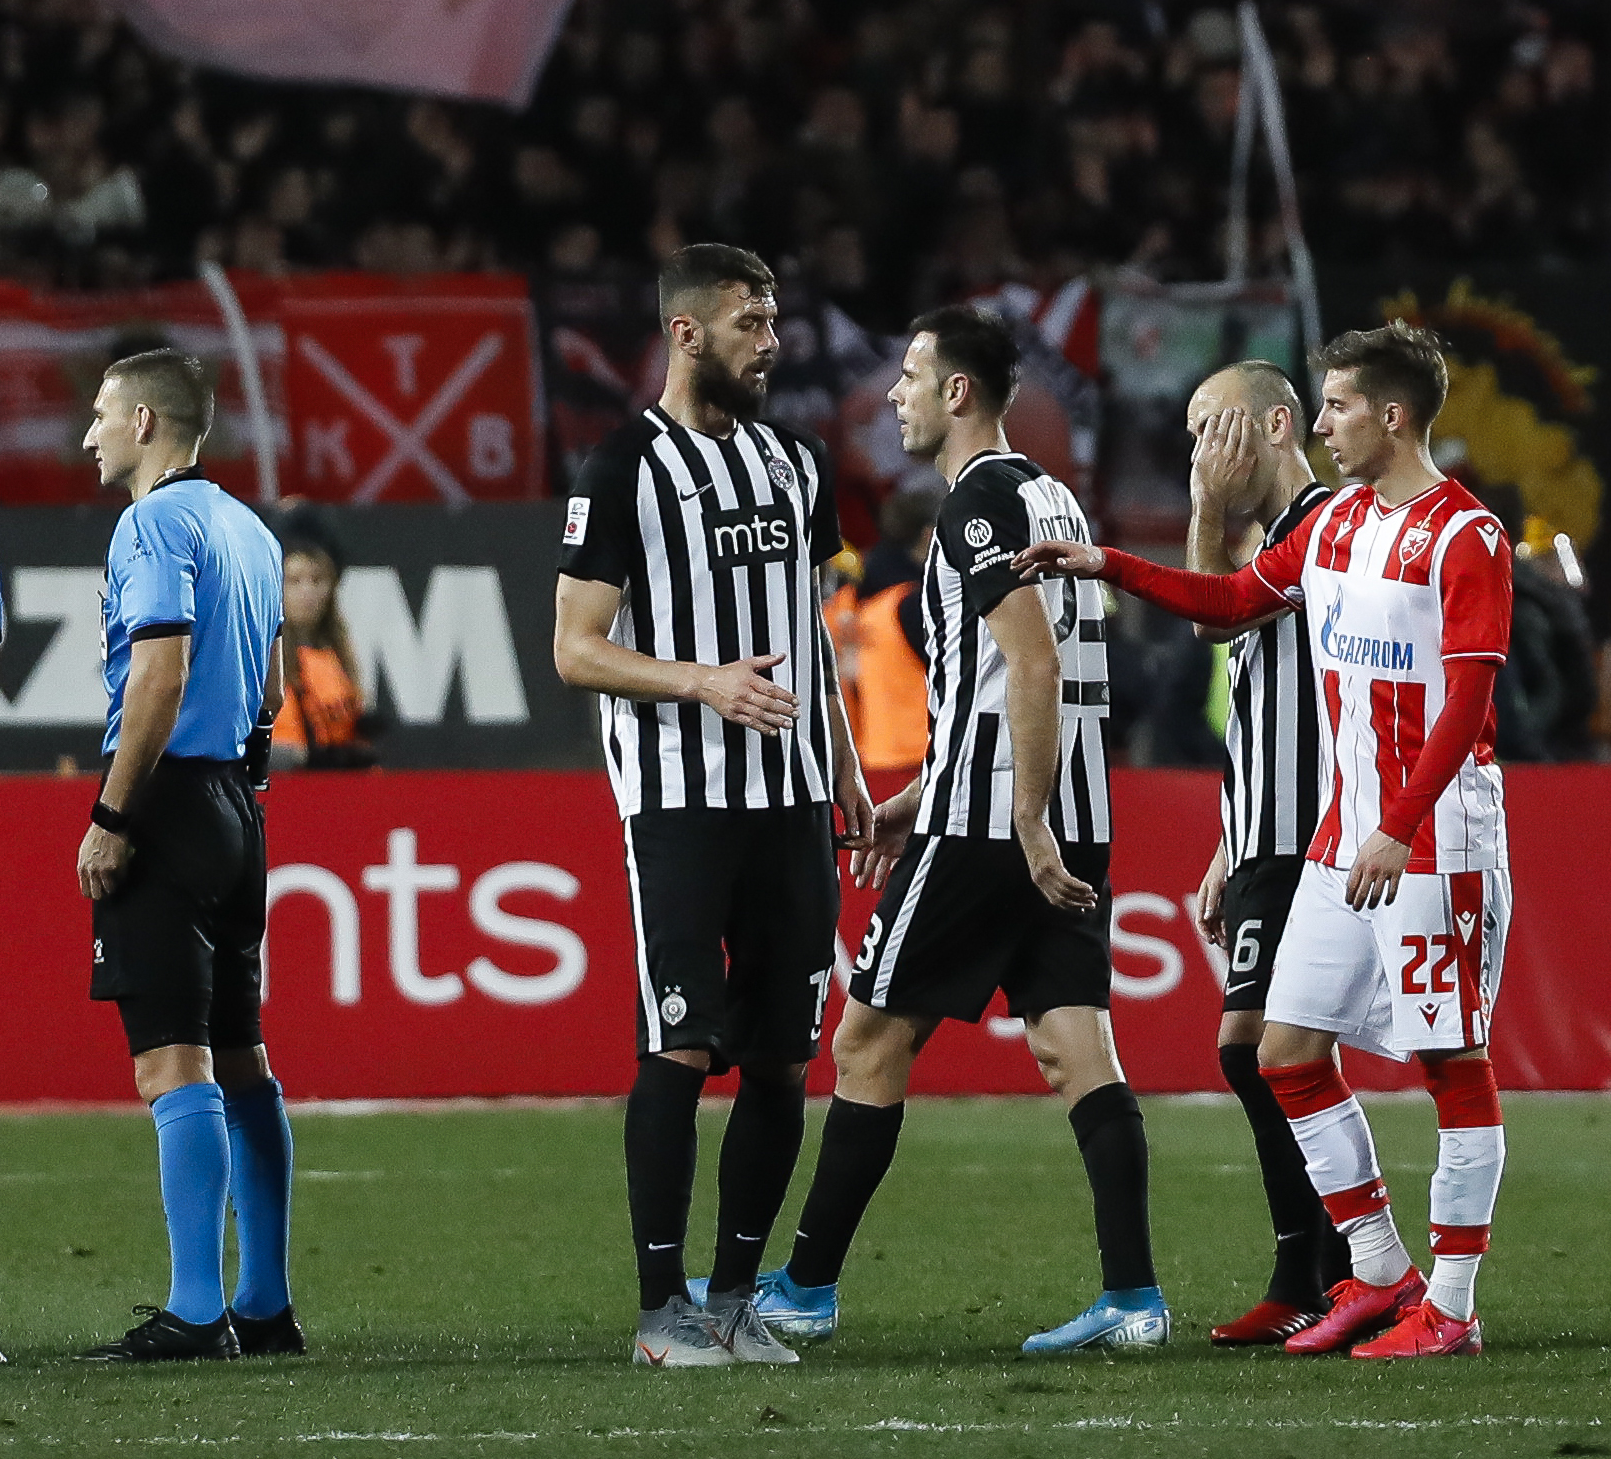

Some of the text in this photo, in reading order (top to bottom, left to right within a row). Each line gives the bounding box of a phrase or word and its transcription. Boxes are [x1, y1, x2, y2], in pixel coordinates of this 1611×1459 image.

[714, 513, 789, 558] mts
[1337, 633, 1414, 670] GAZPROM
[1400, 933, 1456, 995] 22
